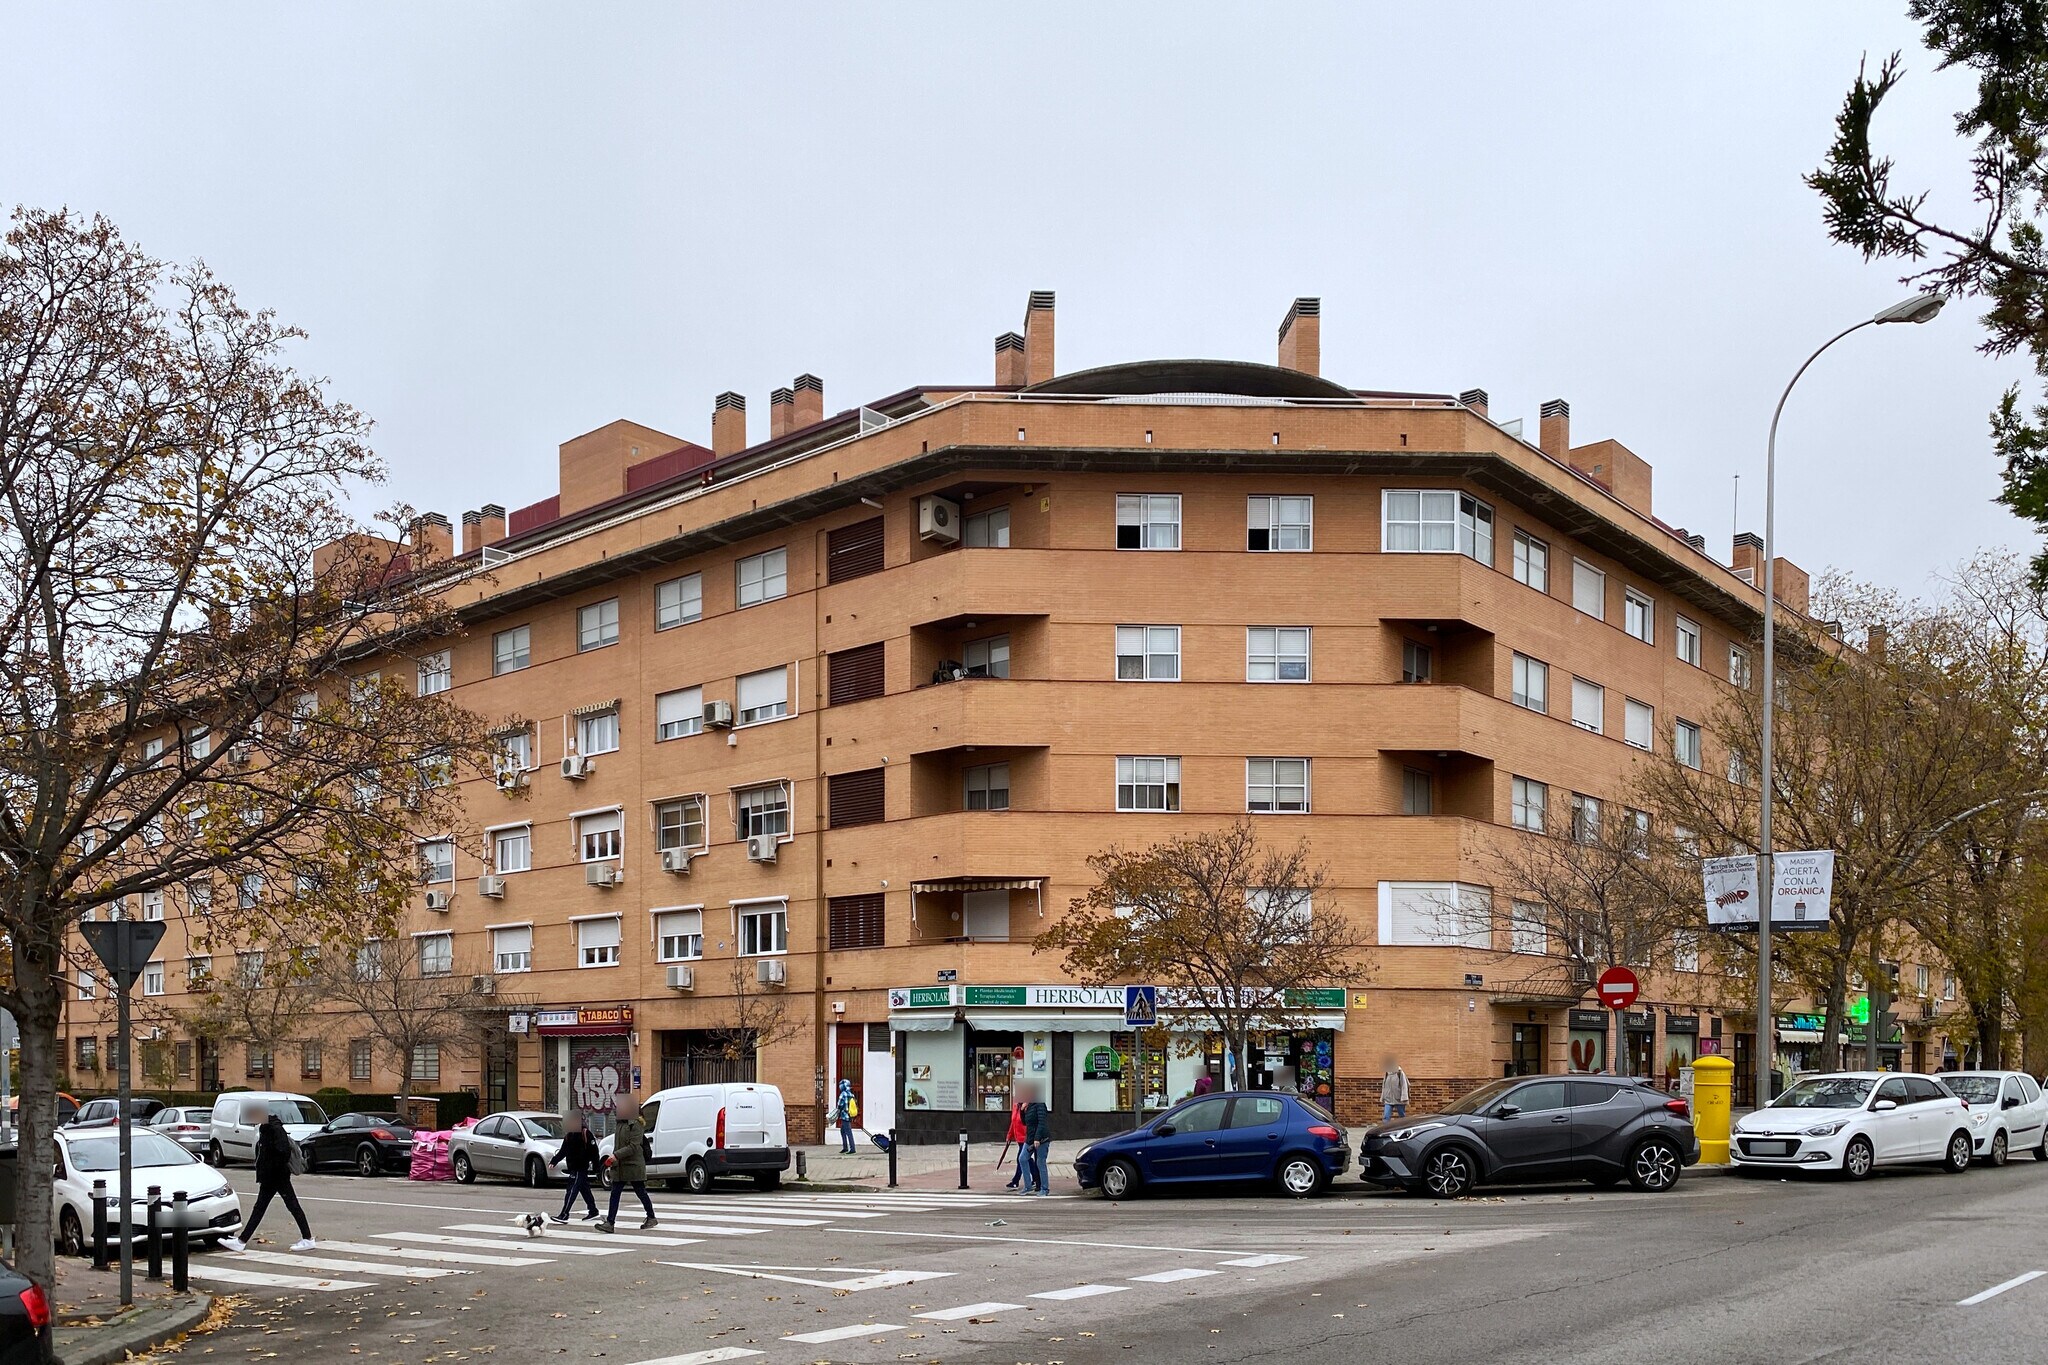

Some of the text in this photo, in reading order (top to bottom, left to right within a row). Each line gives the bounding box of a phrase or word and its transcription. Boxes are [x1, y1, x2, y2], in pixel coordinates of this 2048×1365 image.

[1782, 866, 1820, 875] ACIERTA
[1784, 877, 1818, 886] CON LA
[1035, 989, 1124, 1004] HERBOLAR
[586, 1010, 619, 1020] TABACO
